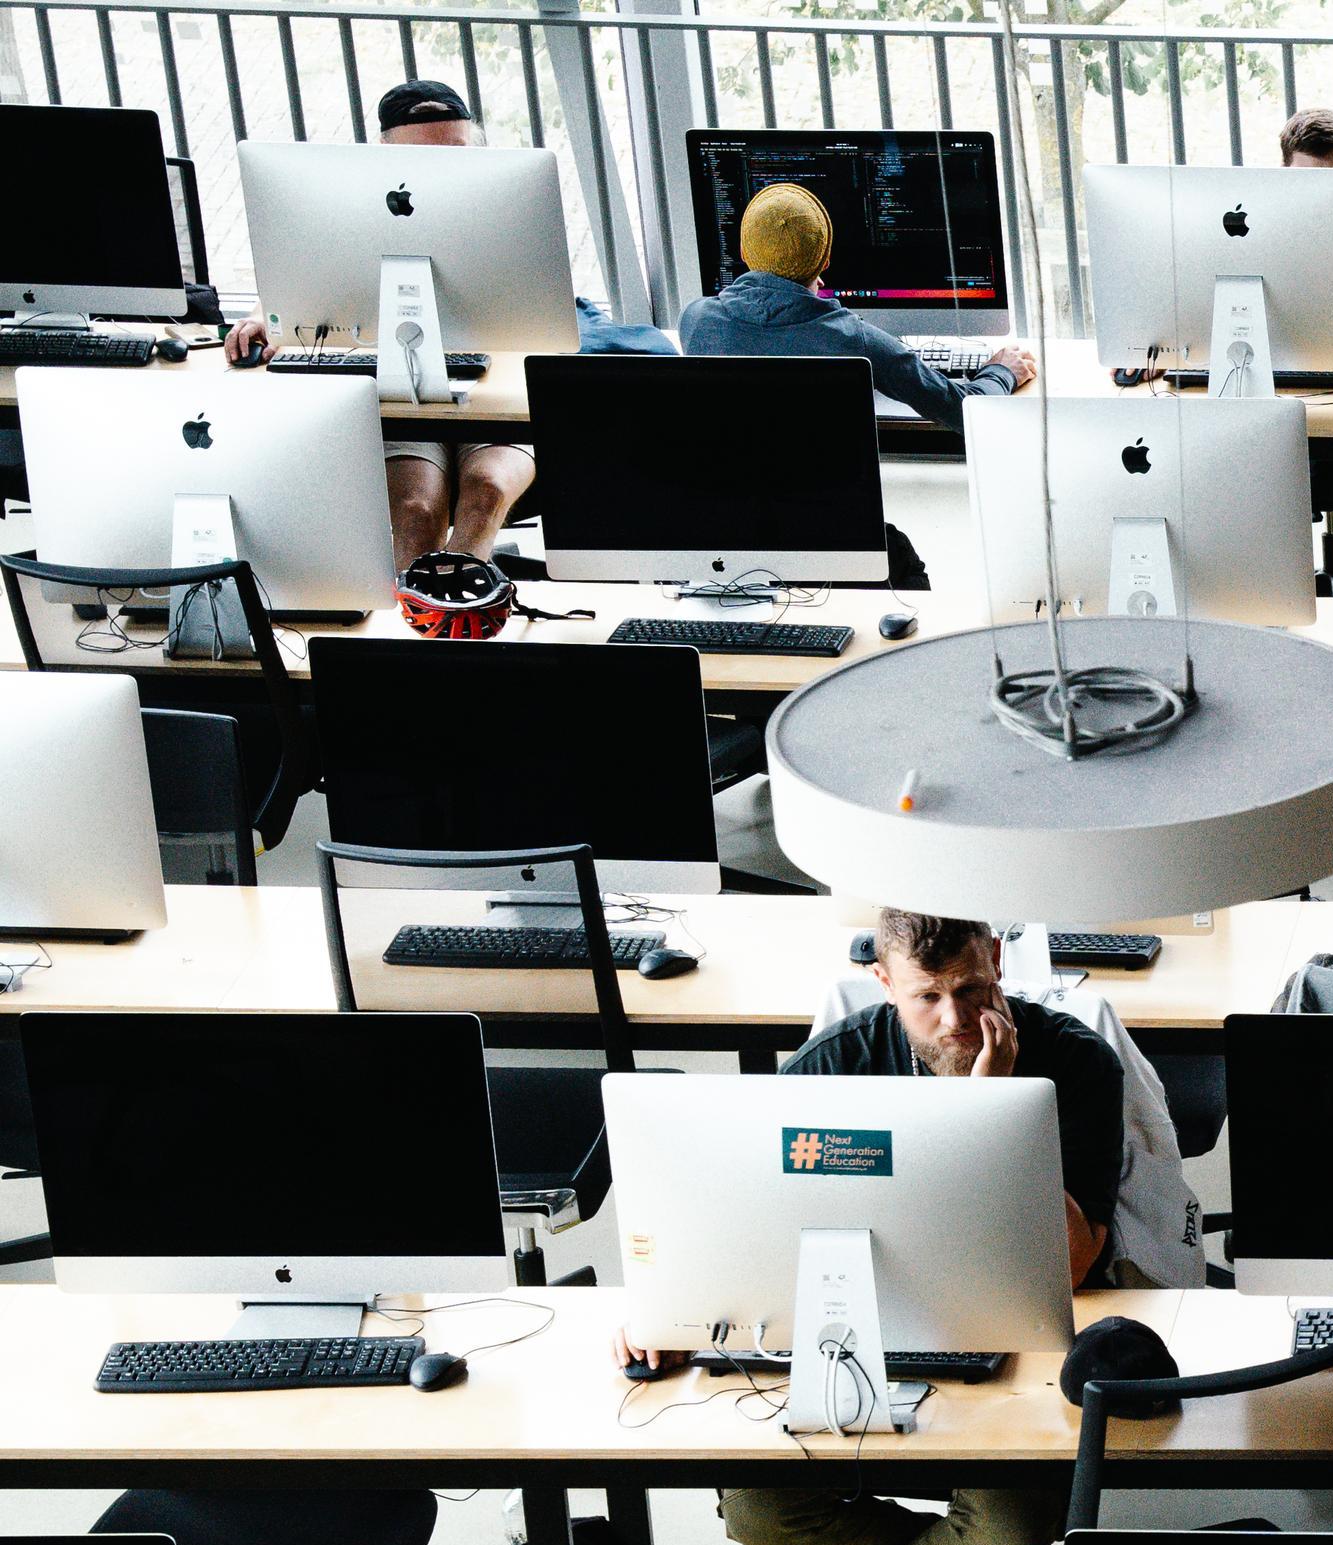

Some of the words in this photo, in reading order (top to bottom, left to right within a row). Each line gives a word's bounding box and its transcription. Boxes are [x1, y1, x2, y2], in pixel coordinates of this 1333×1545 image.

[825, 1134, 852, 1145] Next
[823, 1144, 884, 1156] Generation
[823, 1155, 875, 1166] Education
